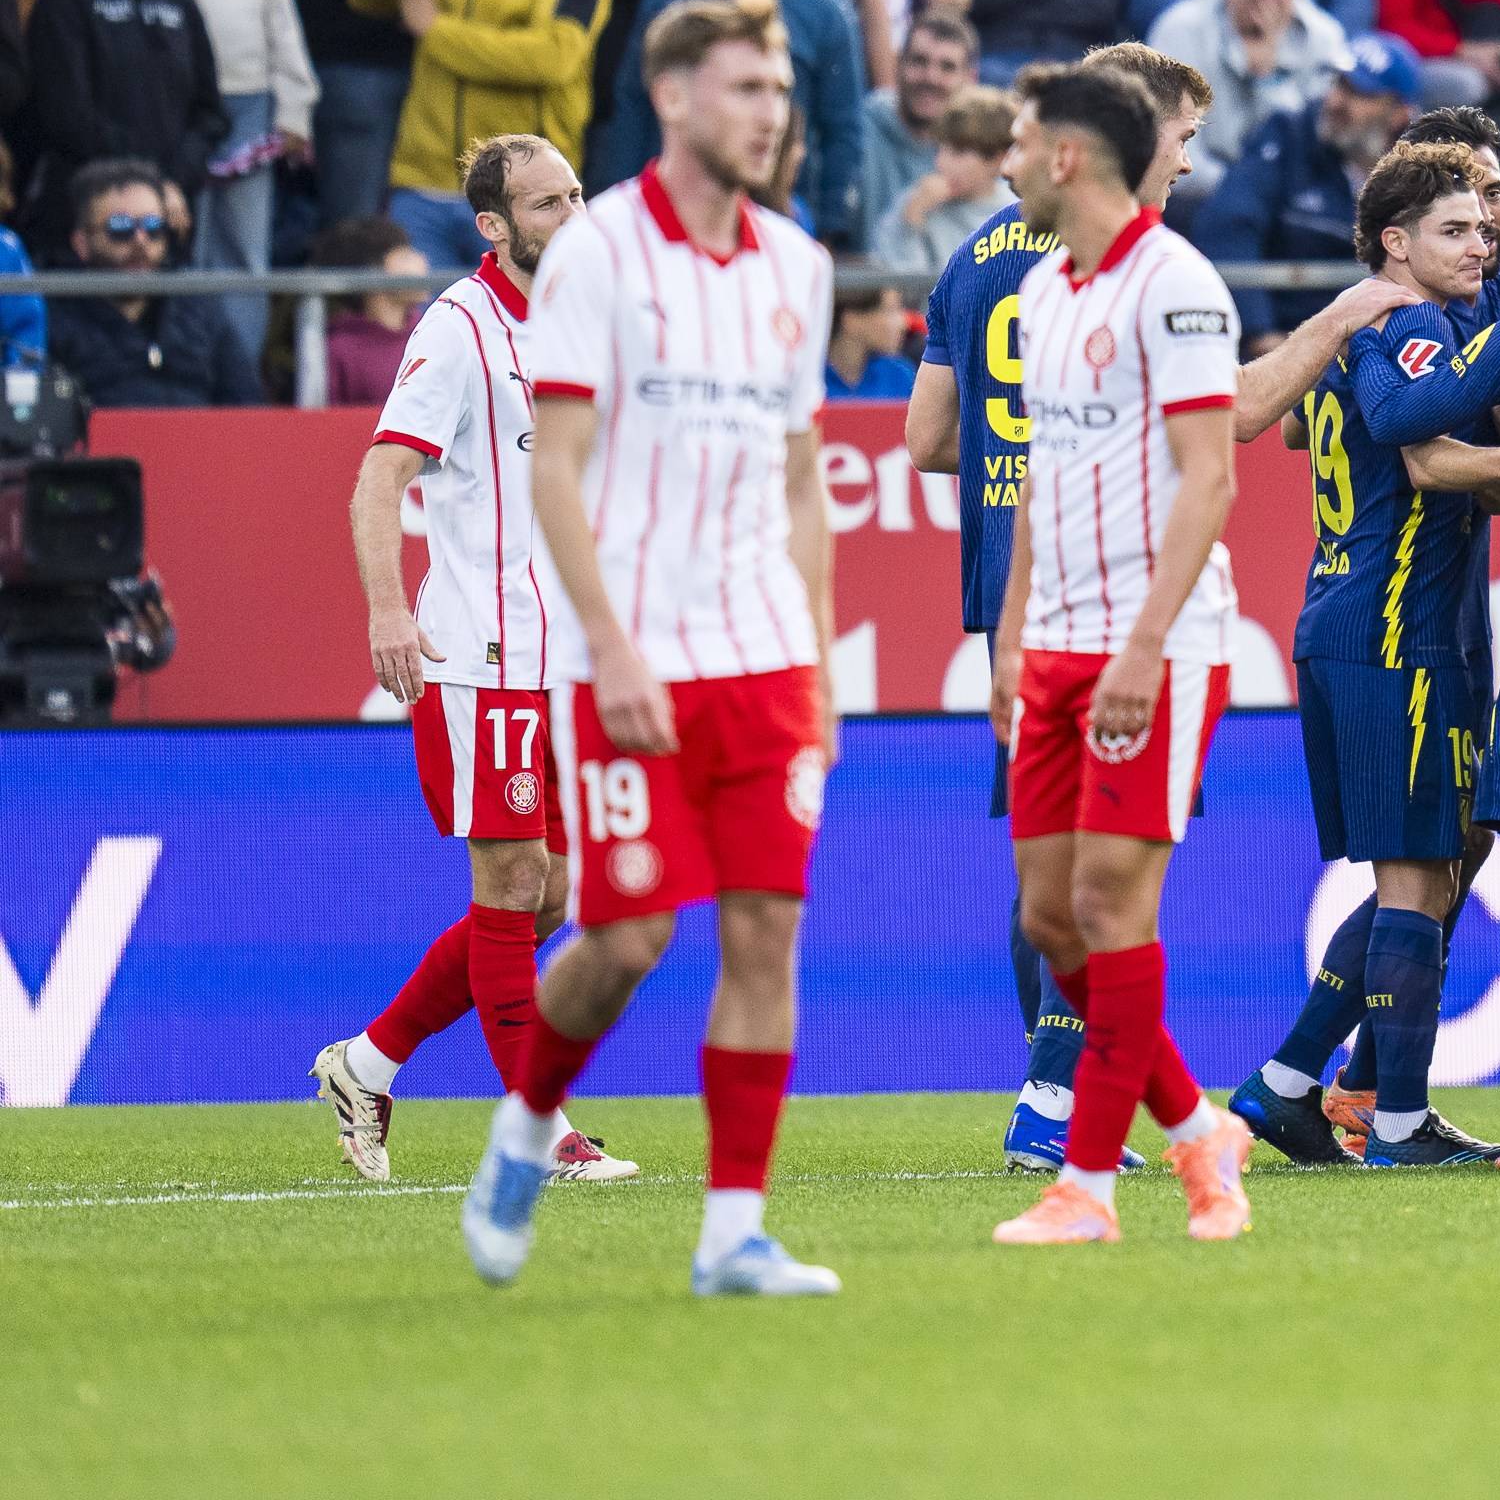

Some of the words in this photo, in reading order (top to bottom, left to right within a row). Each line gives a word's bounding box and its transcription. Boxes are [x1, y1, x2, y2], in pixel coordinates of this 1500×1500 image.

[986, 294, 1031, 443] 9
[984, 455, 1029, 480] VIS
[1304, 390, 1355, 539] 19
[485, 708, 540, 770] 17
[1447, 726, 1473, 789] 19
[579, 756, 652, 843] 19
[1318, 967, 1345, 991] LETI
[1037, 1015, 1085, 1033] ATLETI
